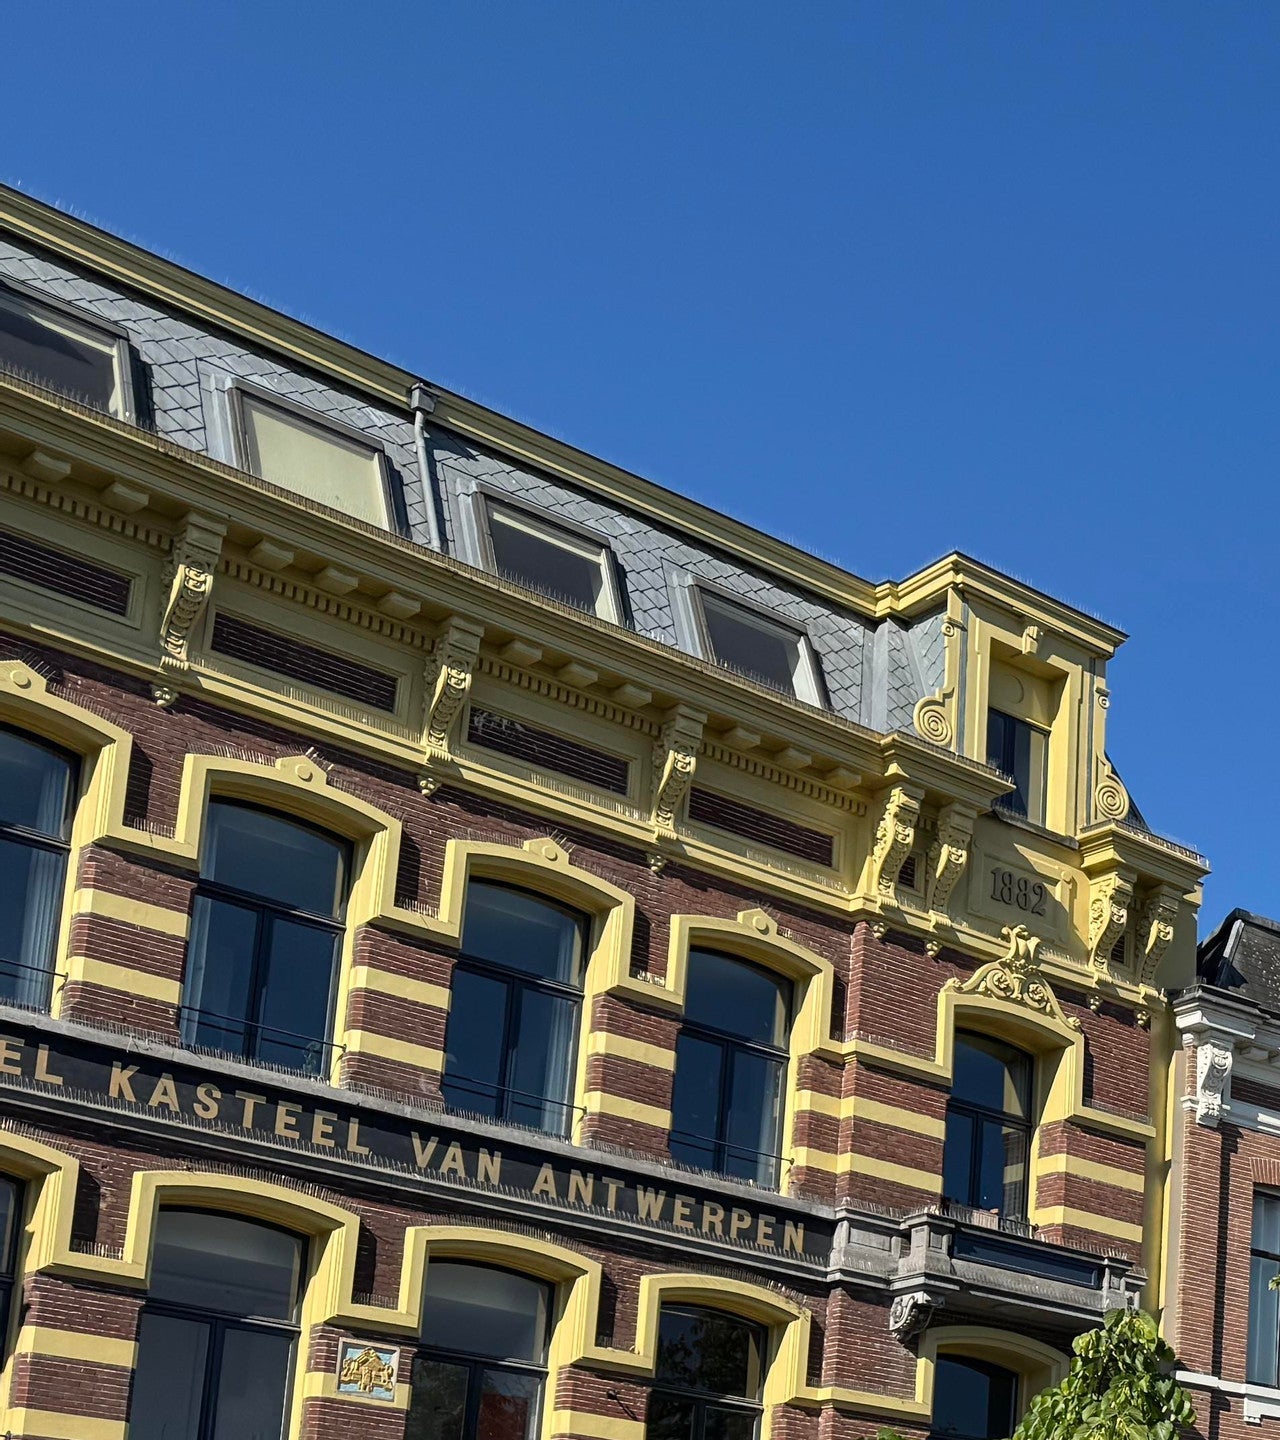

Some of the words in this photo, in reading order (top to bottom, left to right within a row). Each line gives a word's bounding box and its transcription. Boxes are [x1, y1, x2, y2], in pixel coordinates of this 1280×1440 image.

[990, 866, 1048, 917] 1882
[108, 1061, 370, 1155] KASTEEL
[411, 1131, 502, 1185] VAN
[531, 1163, 804, 1254] ANTWERPEN
